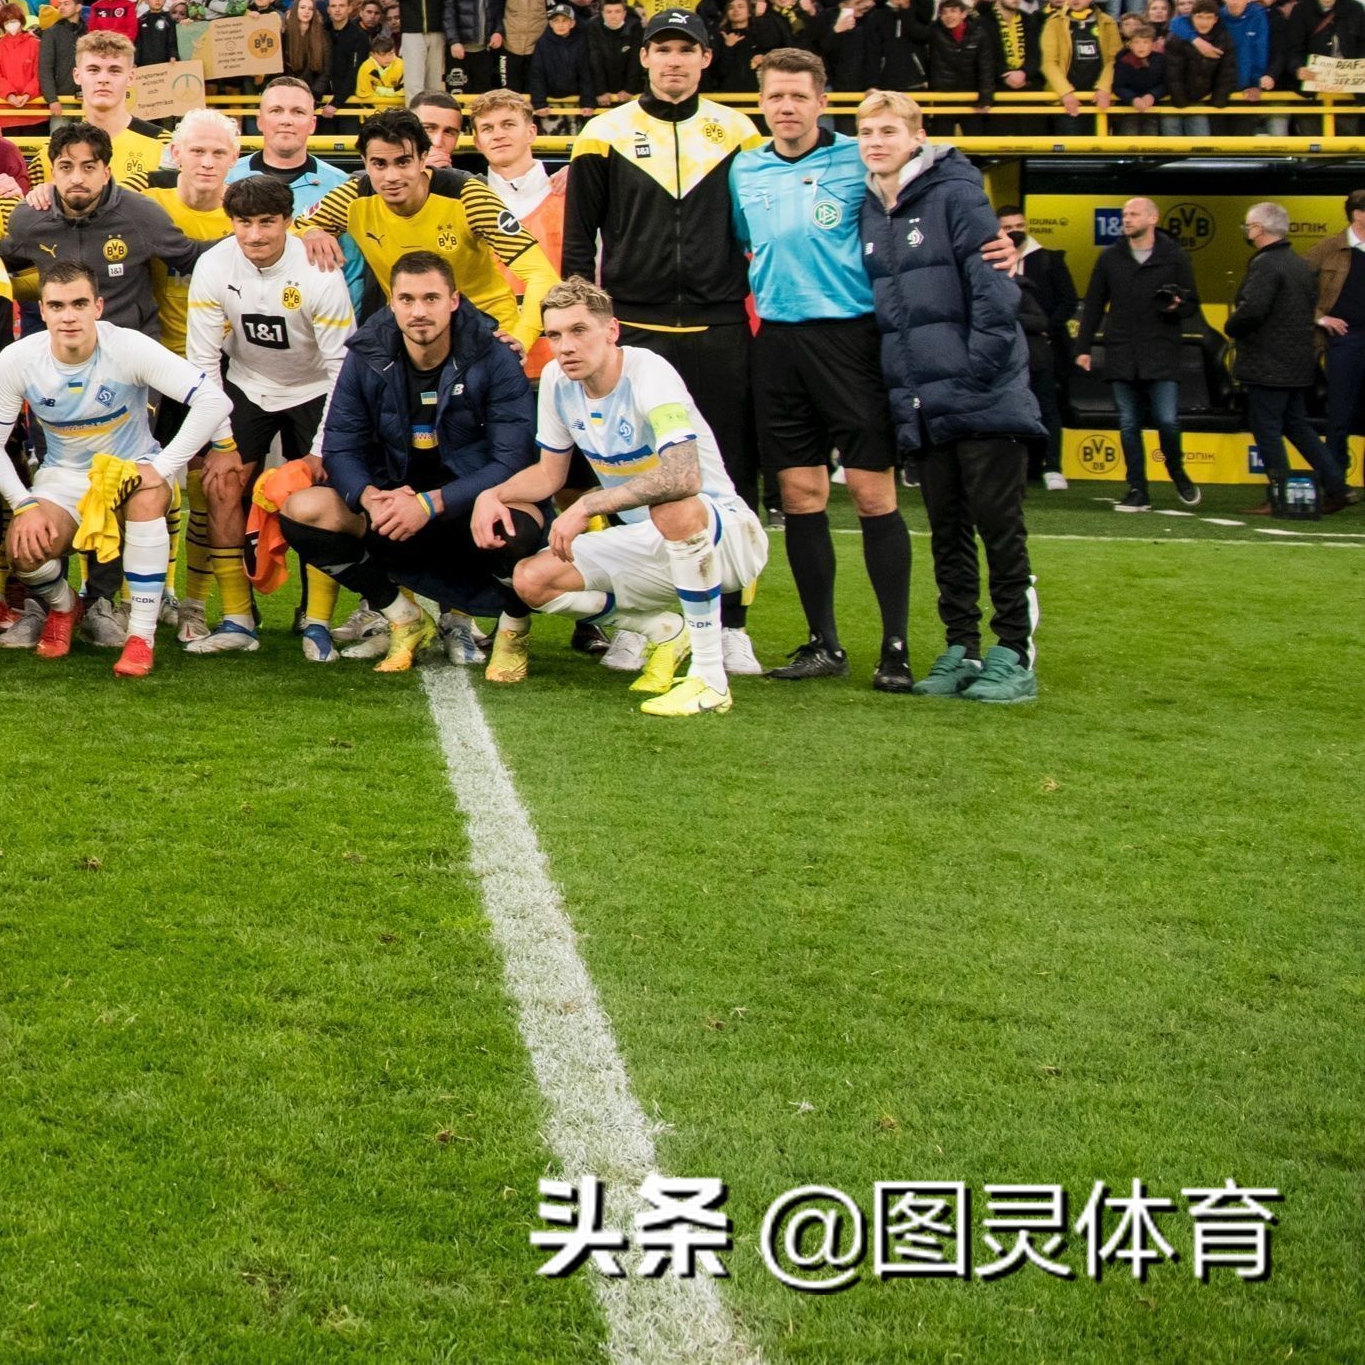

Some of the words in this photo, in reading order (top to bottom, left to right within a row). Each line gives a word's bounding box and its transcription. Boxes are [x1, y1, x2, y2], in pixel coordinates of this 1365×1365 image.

[254, 33, 274, 49] BVB
[1169, 208, 1210, 237] BVB
[439, 233, 458, 247] BVB
[107, 242, 125, 256] BVB
[110, 268, 123, 276] 1&1
[284, 289, 300, 304] BVB
[245, 322, 284, 344] 1&1
[1083, 439, 1116, 463] BVB
